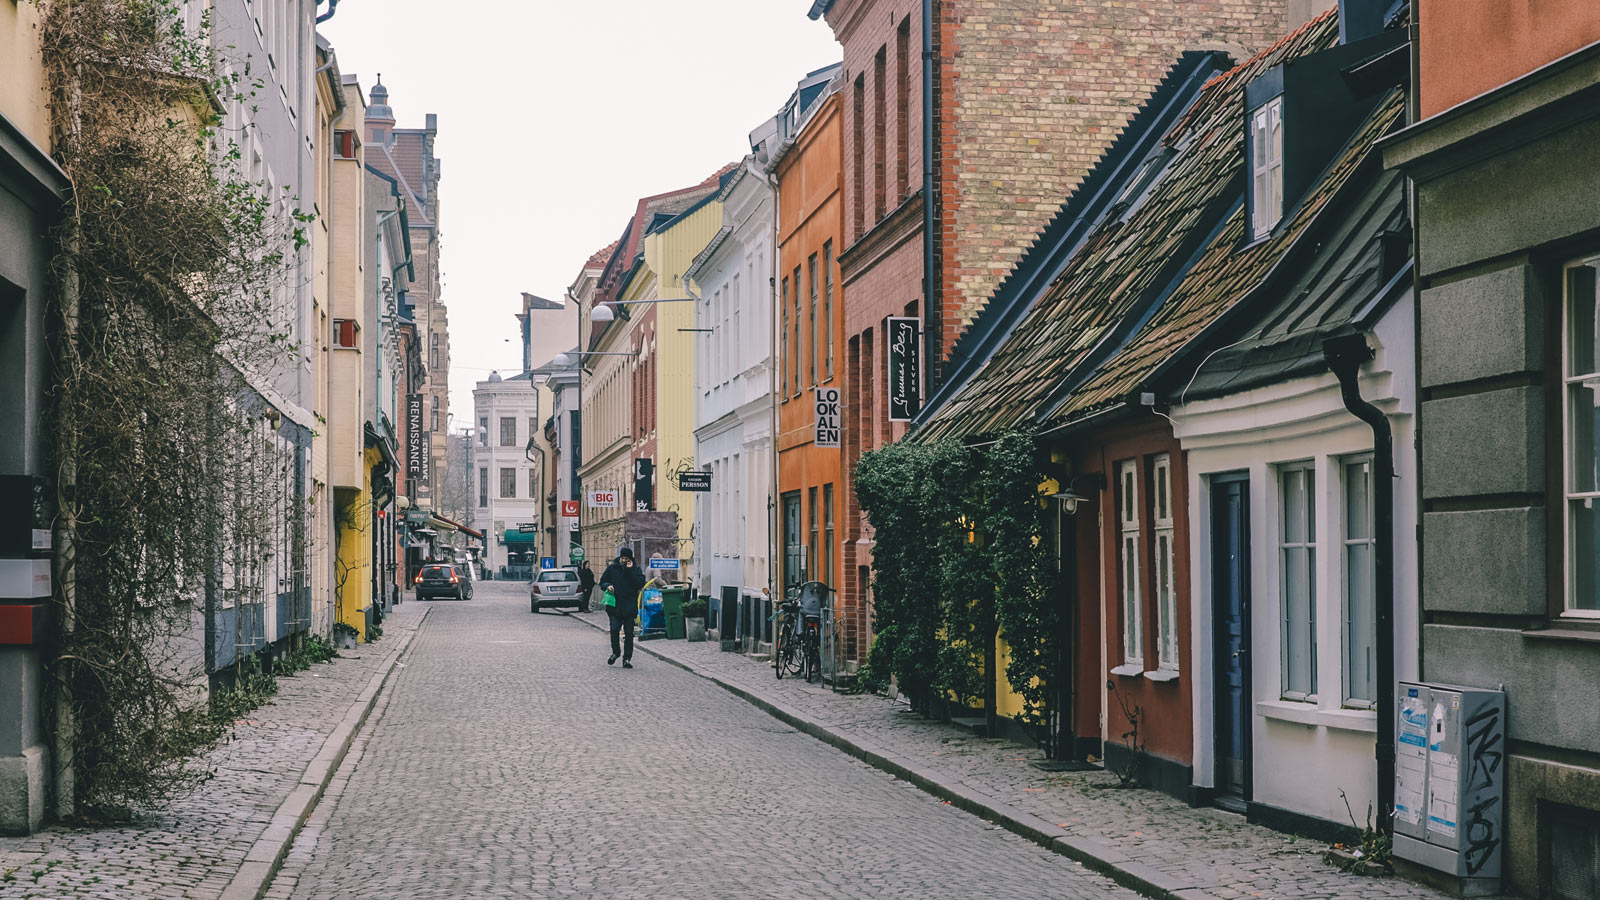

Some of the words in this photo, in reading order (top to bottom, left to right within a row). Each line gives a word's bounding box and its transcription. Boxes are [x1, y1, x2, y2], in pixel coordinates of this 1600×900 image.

[893, 323, 912, 357] Berg
[817, 390, 838, 402] LO
[817, 403, 838, 415] OK
[817, 417, 838, 429] AL
[410, 401, 420, 473] RENAISSANCE
[817, 430, 838, 442] EN
[595, 493, 614, 502] BIG
